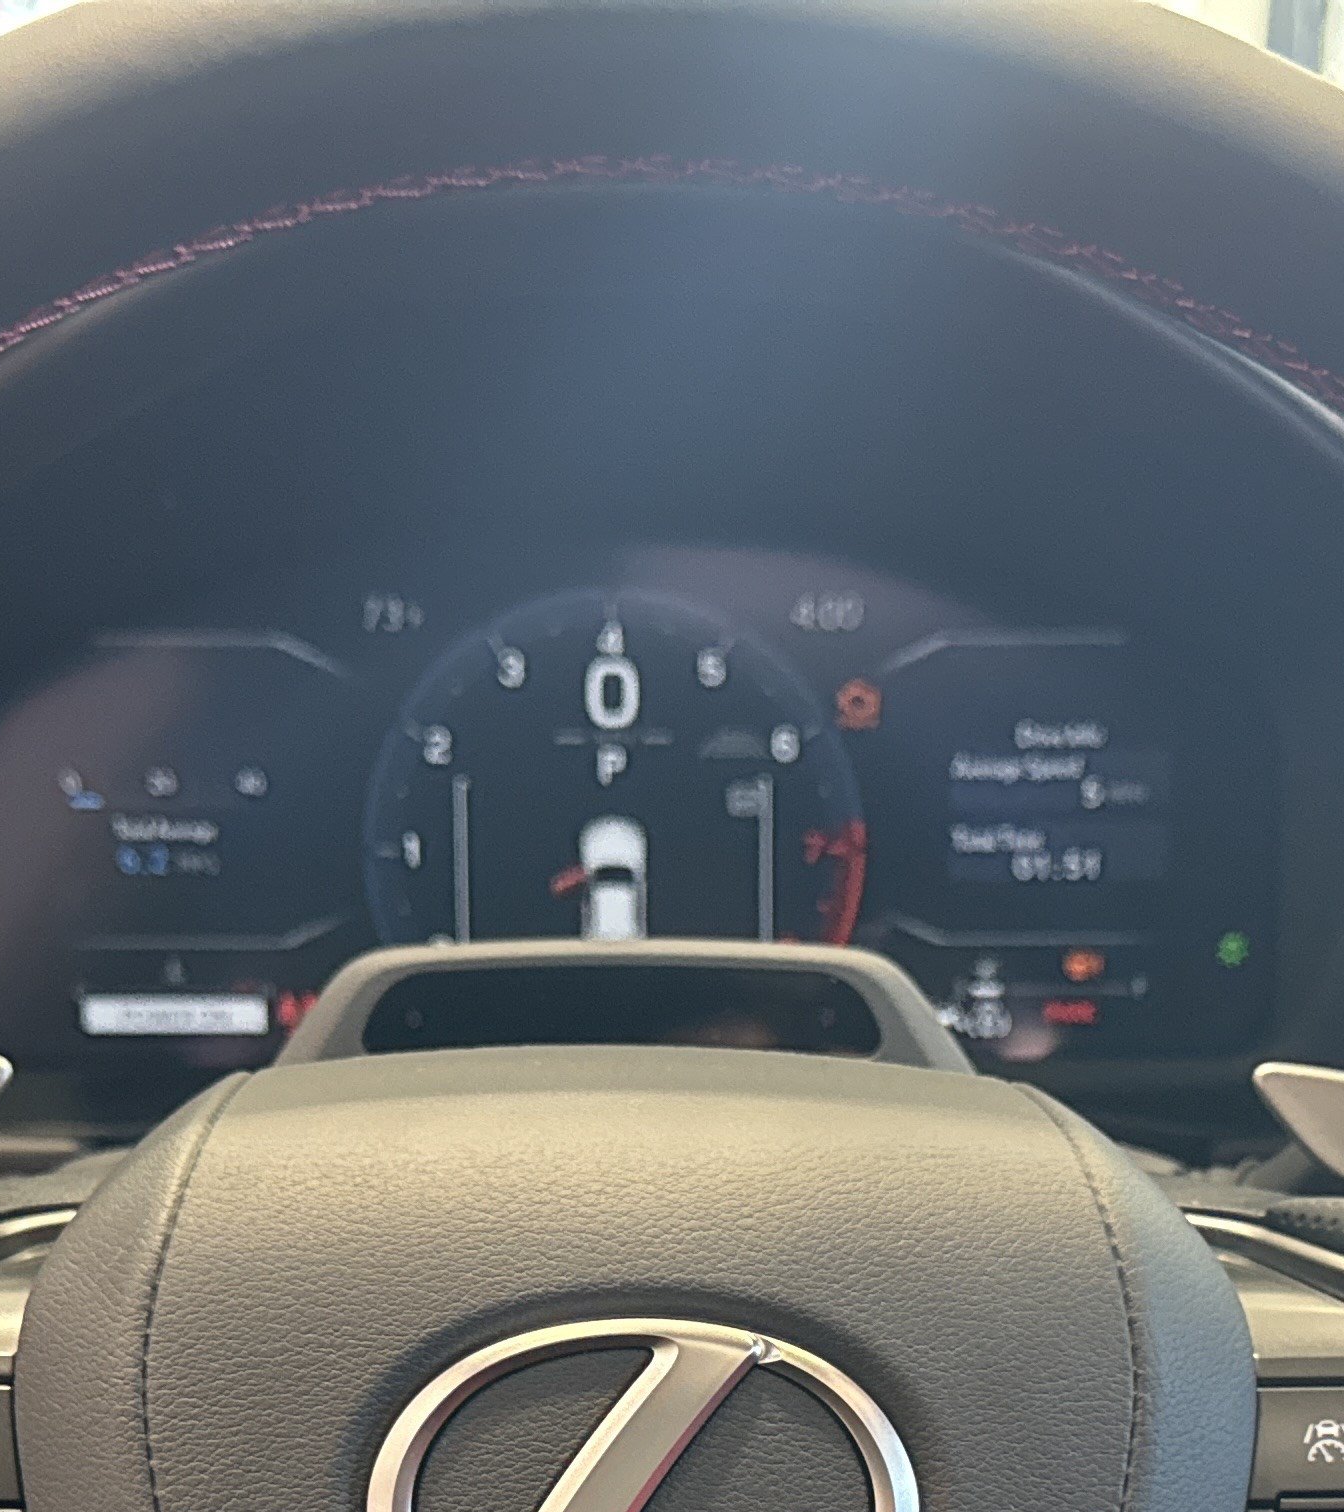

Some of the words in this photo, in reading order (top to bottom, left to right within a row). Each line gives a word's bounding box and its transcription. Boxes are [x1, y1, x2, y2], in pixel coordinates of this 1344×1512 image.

[498, 647, 525, 688] 3
[585, 655, 639, 729] 0
[424, 725, 452, 765] 2
[597, 744, 627, 786] P
